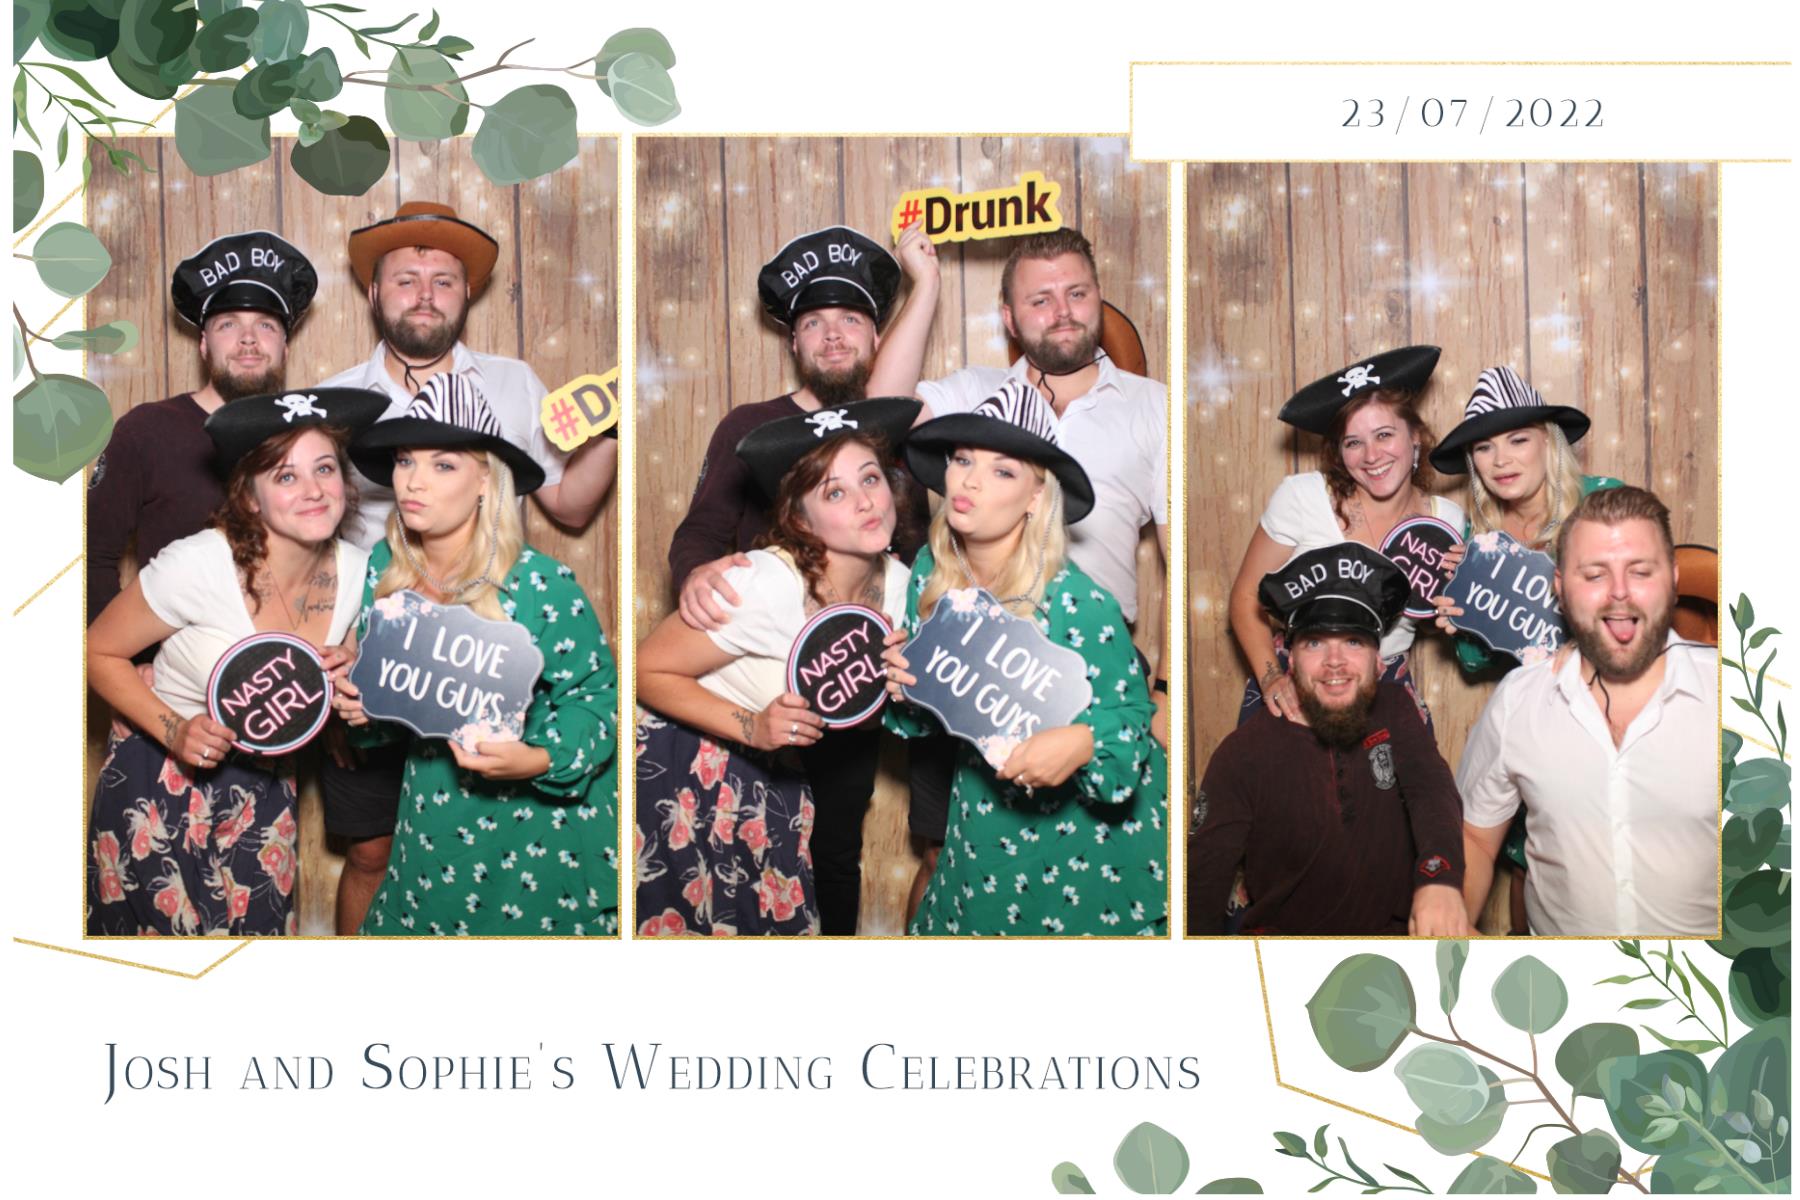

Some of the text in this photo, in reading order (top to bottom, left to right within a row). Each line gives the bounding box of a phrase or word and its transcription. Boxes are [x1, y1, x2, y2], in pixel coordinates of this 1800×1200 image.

[898, 180, 1053, 236] #Drunk
[199, 246, 286, 287] BAD BOY
[780, 243, 863, 288] BAD BOY
[1283, 558, 1376, 599] BAD BOY
[1399, 530, 1446, 571] NAST
[1490, 553, 1507, 580] I
[1465, 580, 1563, 652] YOU GUYS
[402, 616, 511, 680] I LOVE
[799, 620, 871, 687] NASTY
[960, 615, 1063, 702] I LOVE
[220, 646, 297, 717] NASTY
[243, 680, 325, 740] GIRL
[378, 656, 505, 727] YOU GUYS
[816, 653, 888, 713] GIRL
[924, 644, 1042, 740] YOU GUYS
